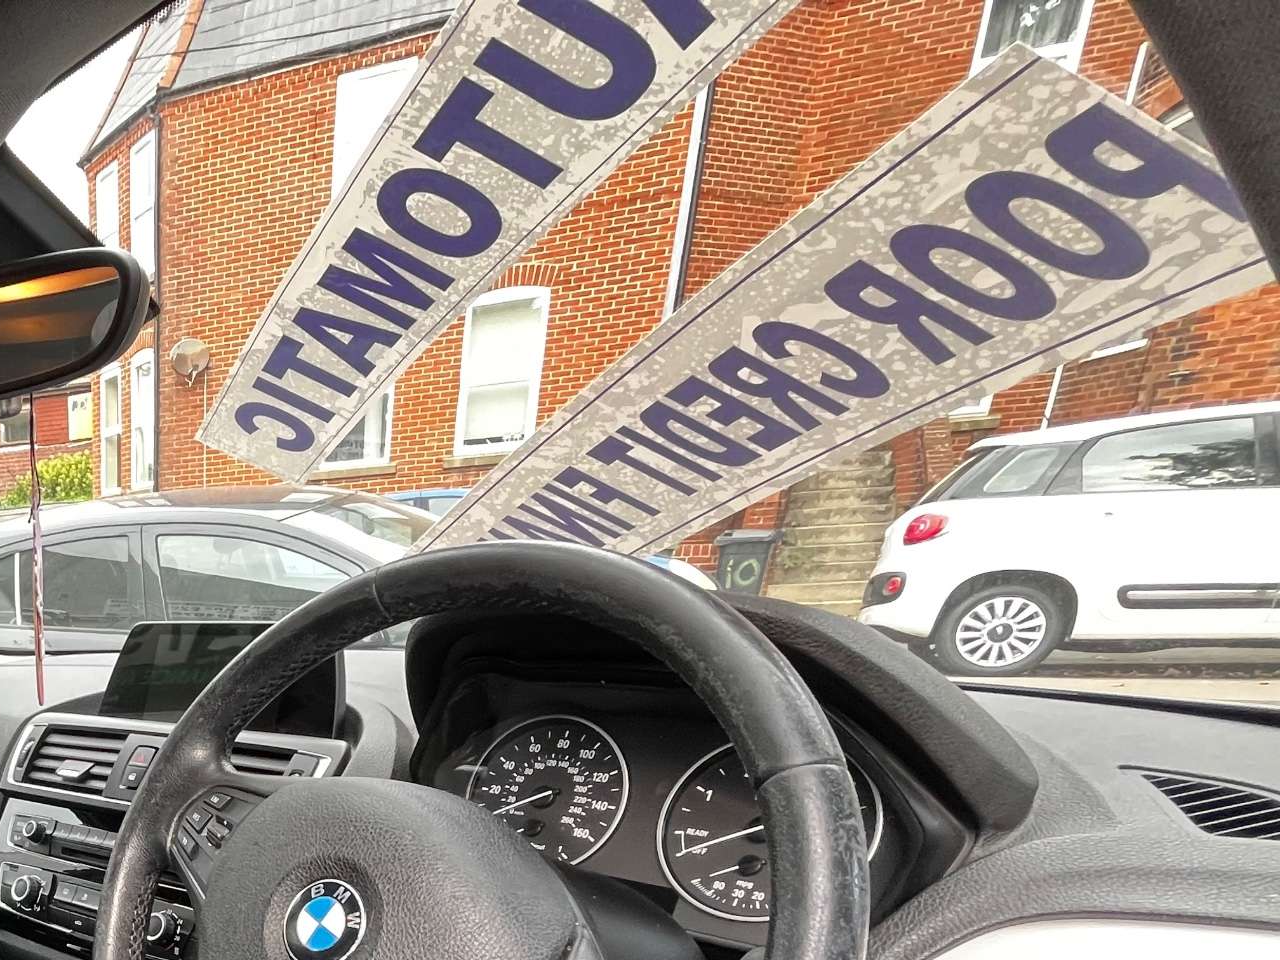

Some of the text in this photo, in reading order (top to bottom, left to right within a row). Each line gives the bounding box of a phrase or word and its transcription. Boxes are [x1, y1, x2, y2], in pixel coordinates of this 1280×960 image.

[529, 743, 541, 752] 60
[557, 739, 570, 748] 80
[579, 750, 595, 759] 100
[503, 761, 515, 770] 40
[593, 772, 609, 782] 120
[489, 785, 501, 794] 20
[706, 789, 713, 801] 1
[591, 800, 608, 810] 140
[573, 828, 589, 838] 160
[686, 827, 709, 837] READY
[731, 888, 745, 898] 30
[751, 891, 765, 901] 20
[311, 884, 361, 929] BMW
